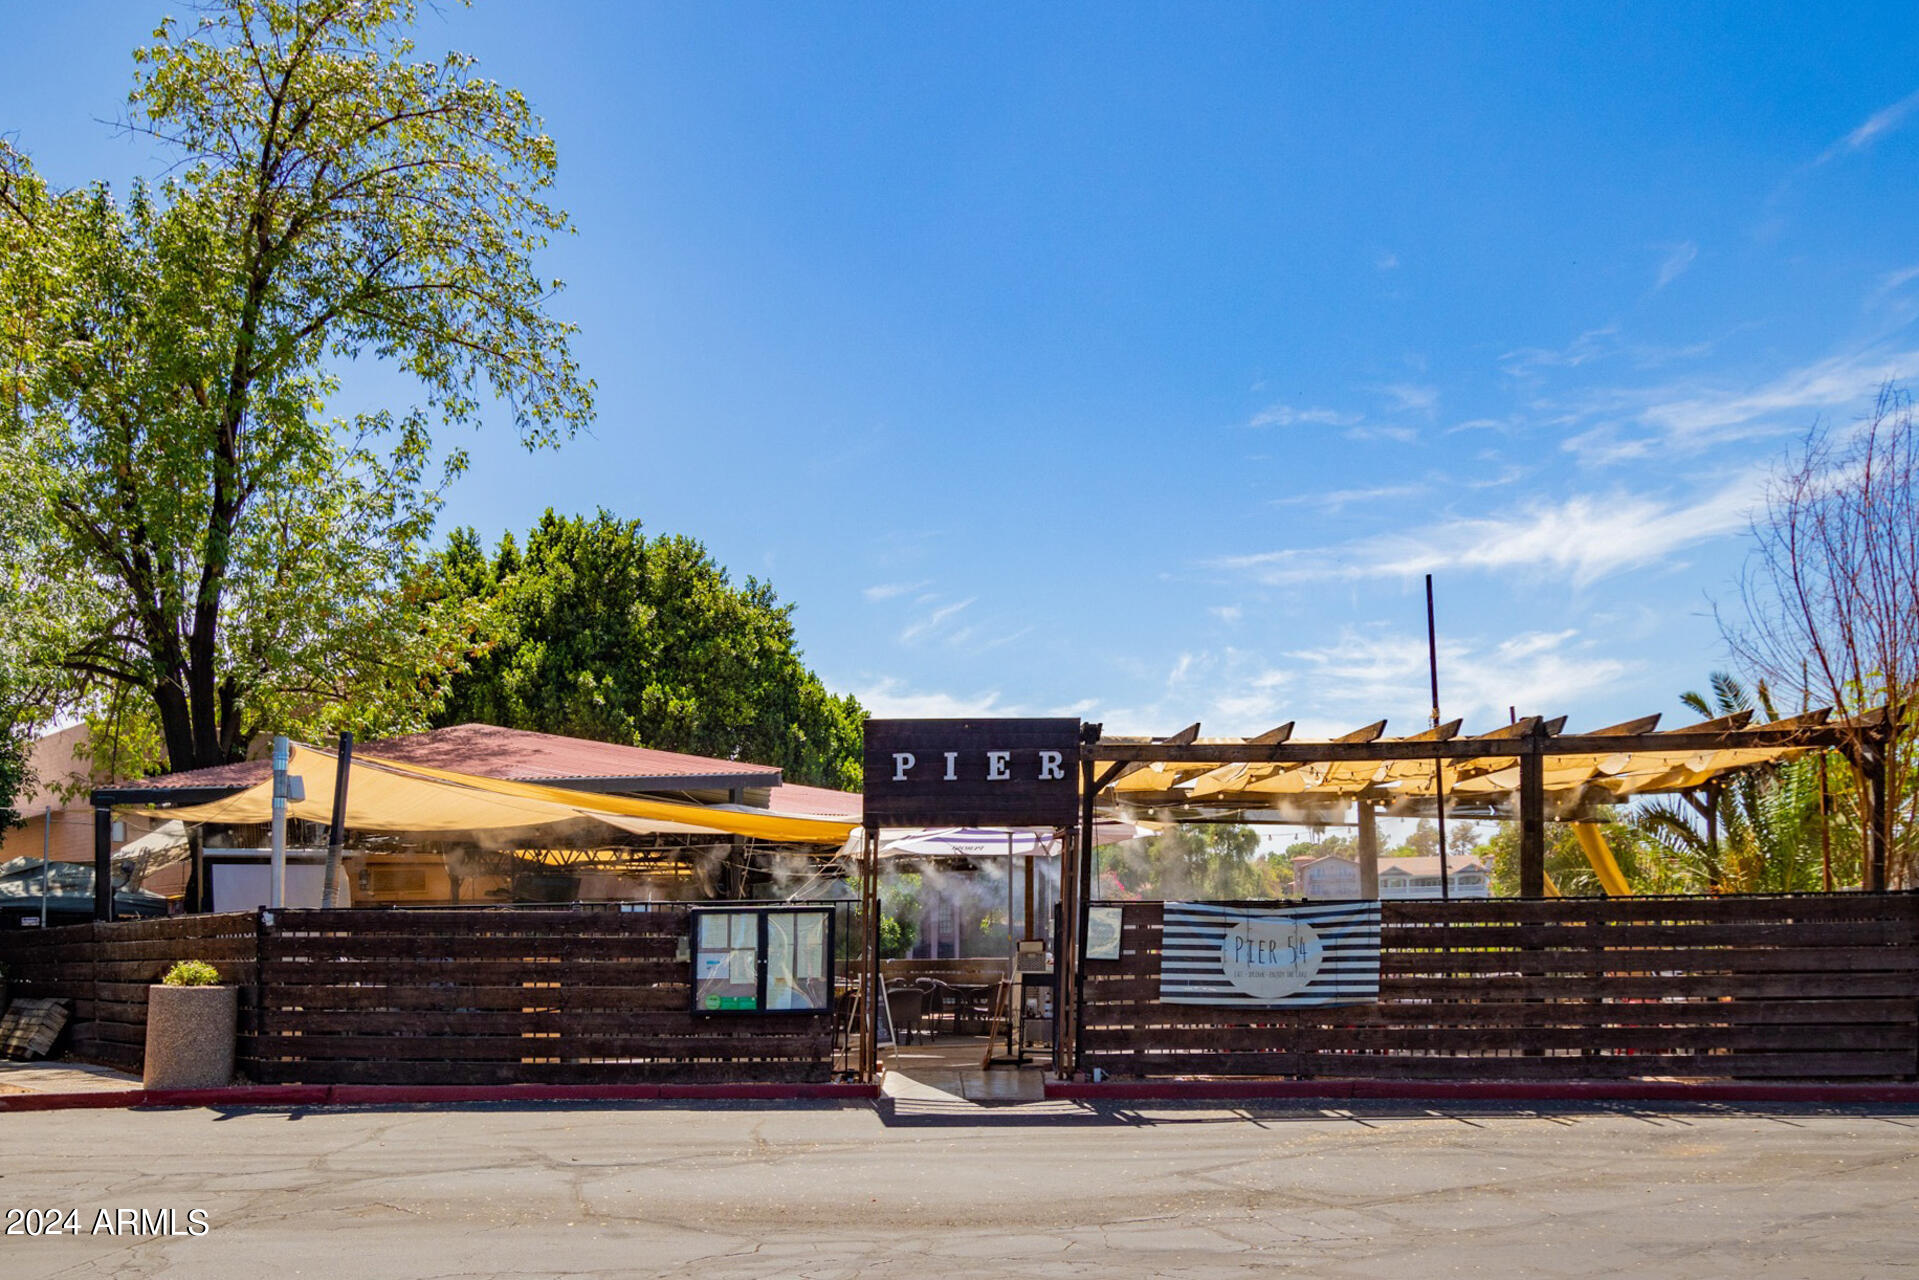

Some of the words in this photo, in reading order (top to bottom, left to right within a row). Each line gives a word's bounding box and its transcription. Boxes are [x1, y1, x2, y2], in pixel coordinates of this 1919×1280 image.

[892, 751, 1065, 781] PIER
[1235, 935, 1278, 964] PIER
[1287, 935, 1308, 964] 54
